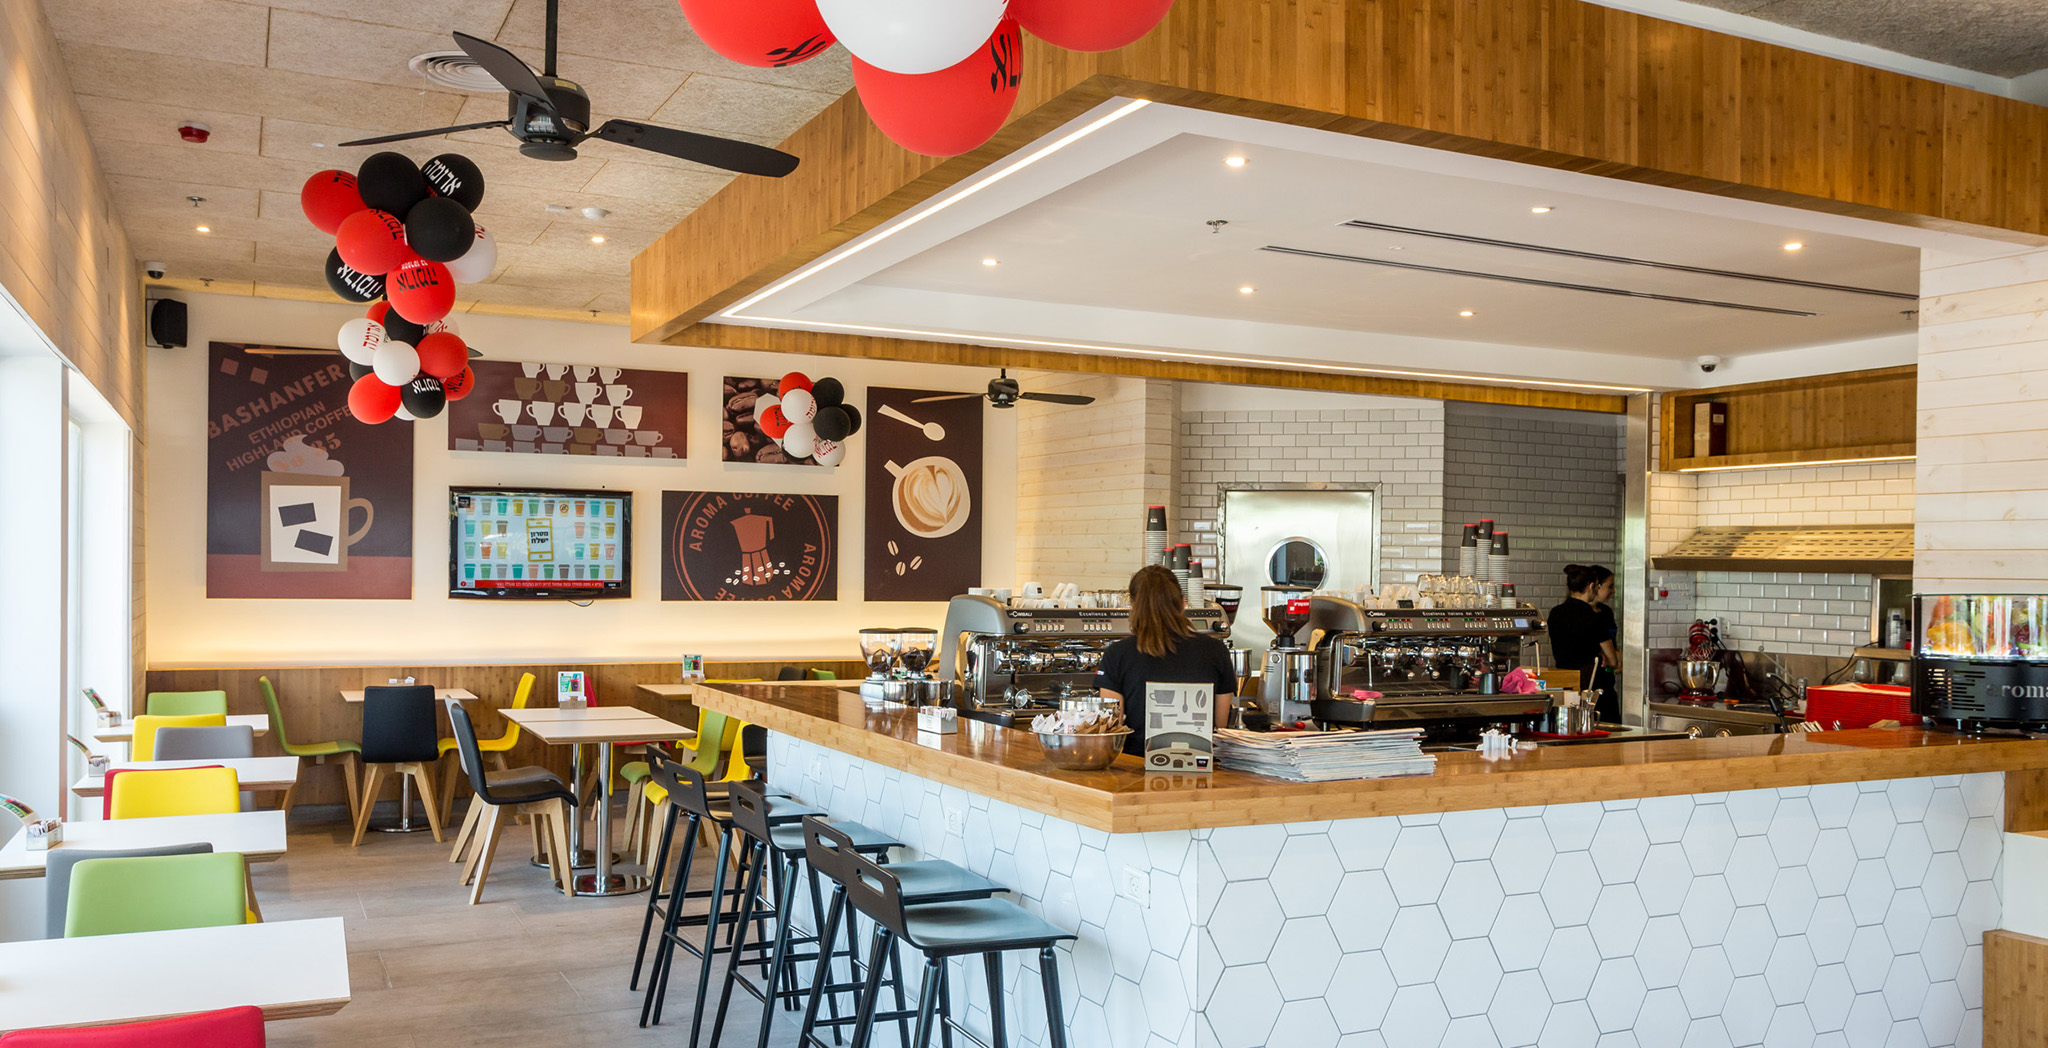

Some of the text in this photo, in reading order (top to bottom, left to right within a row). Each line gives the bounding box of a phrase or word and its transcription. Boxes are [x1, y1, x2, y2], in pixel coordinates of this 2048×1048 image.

[423, 158, 462, 196] ארומה
[336, 264, 383, 298] ארומה
[396, 267, 438, 293] ארומה
[209, 364, 346, 439] BASHANFER
[411, 378, 440, 394] ארומה
[226, 405, 351, 472] HIGHLAND COFFE
[248, 401, 327, 444] ETHIOPIAN
[689, 495, 728, 552] AROMA
[781, 543, 816, 599] AROMA
